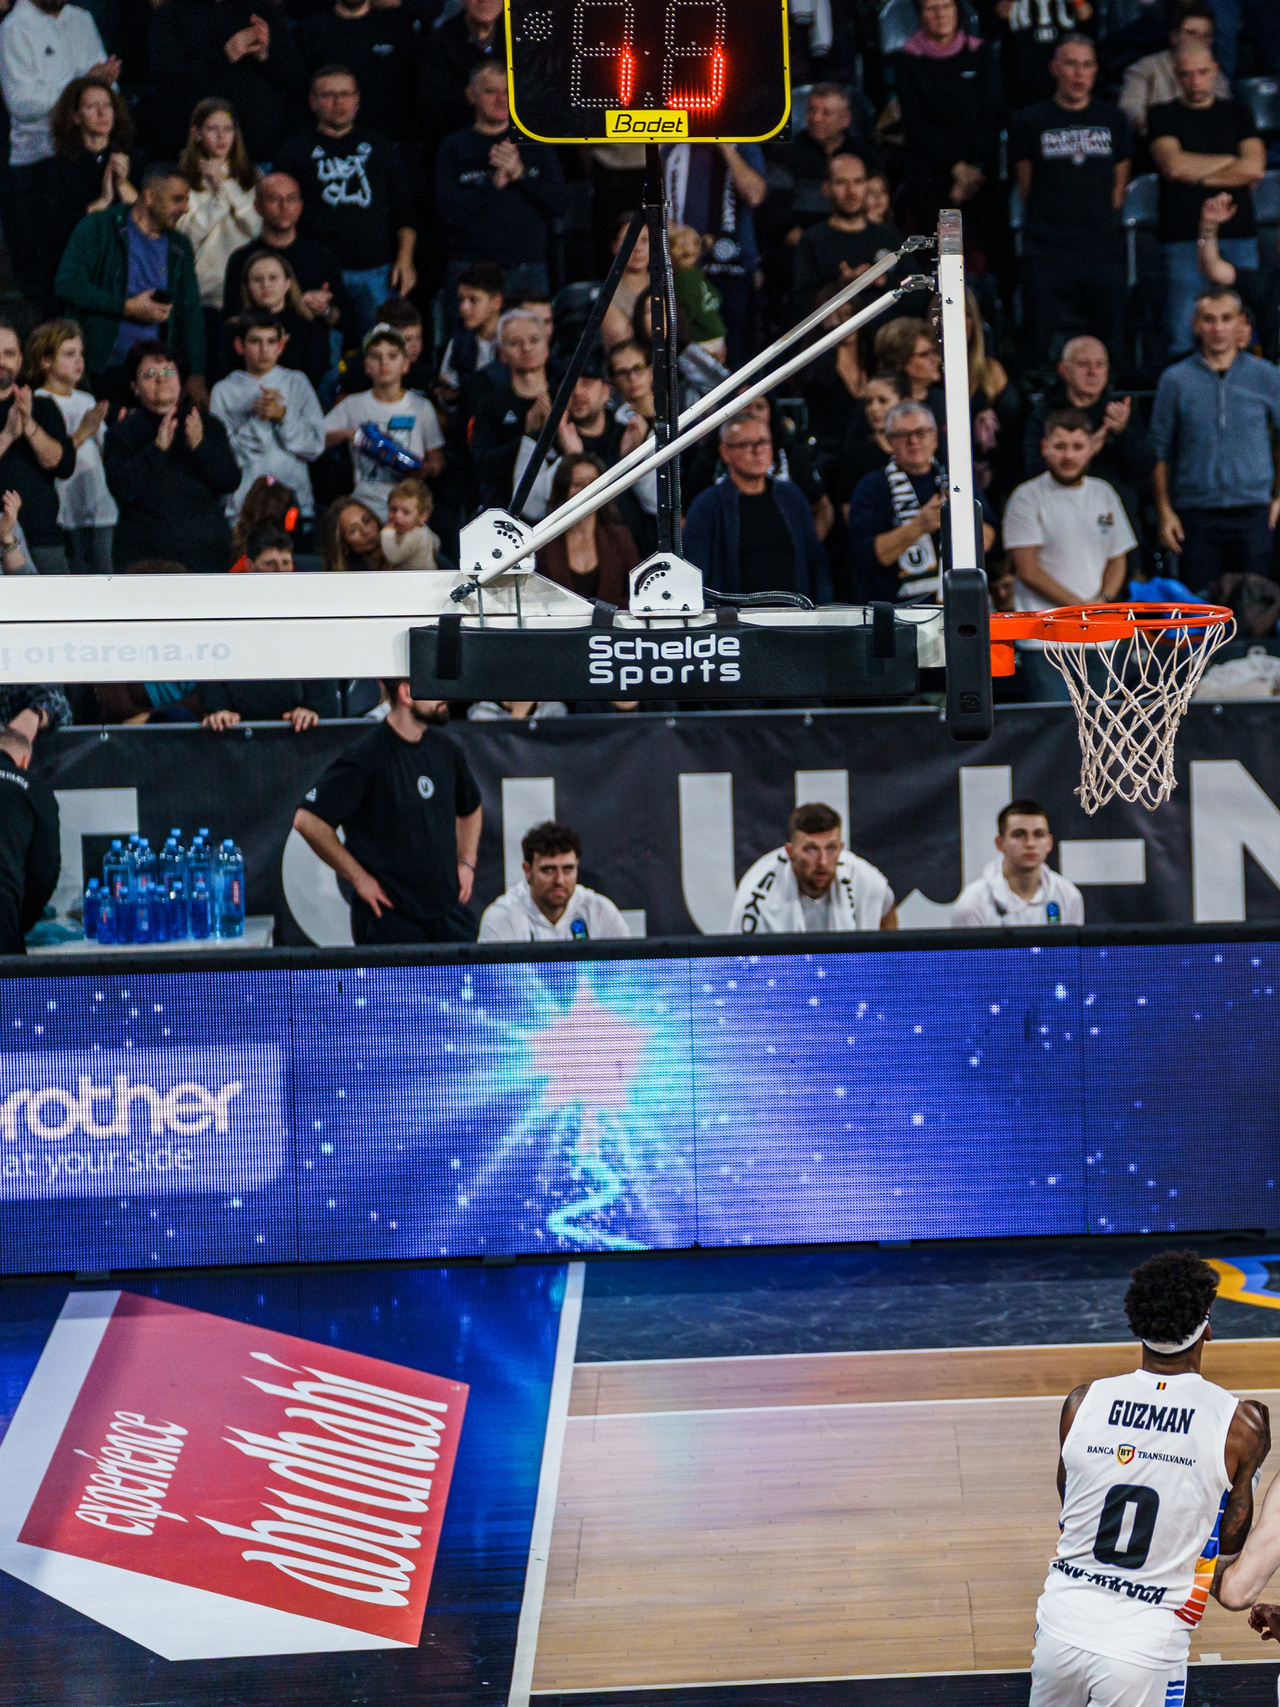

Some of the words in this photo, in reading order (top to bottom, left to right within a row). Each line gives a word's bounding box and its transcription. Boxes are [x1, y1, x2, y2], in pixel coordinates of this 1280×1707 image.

[612, 113, 684, 133] Bodet
[588, 633, 741, 660] Schelde
[588, 659, 742, 691] Sports
[44, 1149, 120, 1183] your
[128, 1142, 194, 1171] side
[1107, 1399, 1196, 1435] GUZMAN
[1087, 1445, 1115, 1456] BANCA
[1120, 1448, 1132, 1457] BT
[1092, 1484, 1160, 1570] 0
